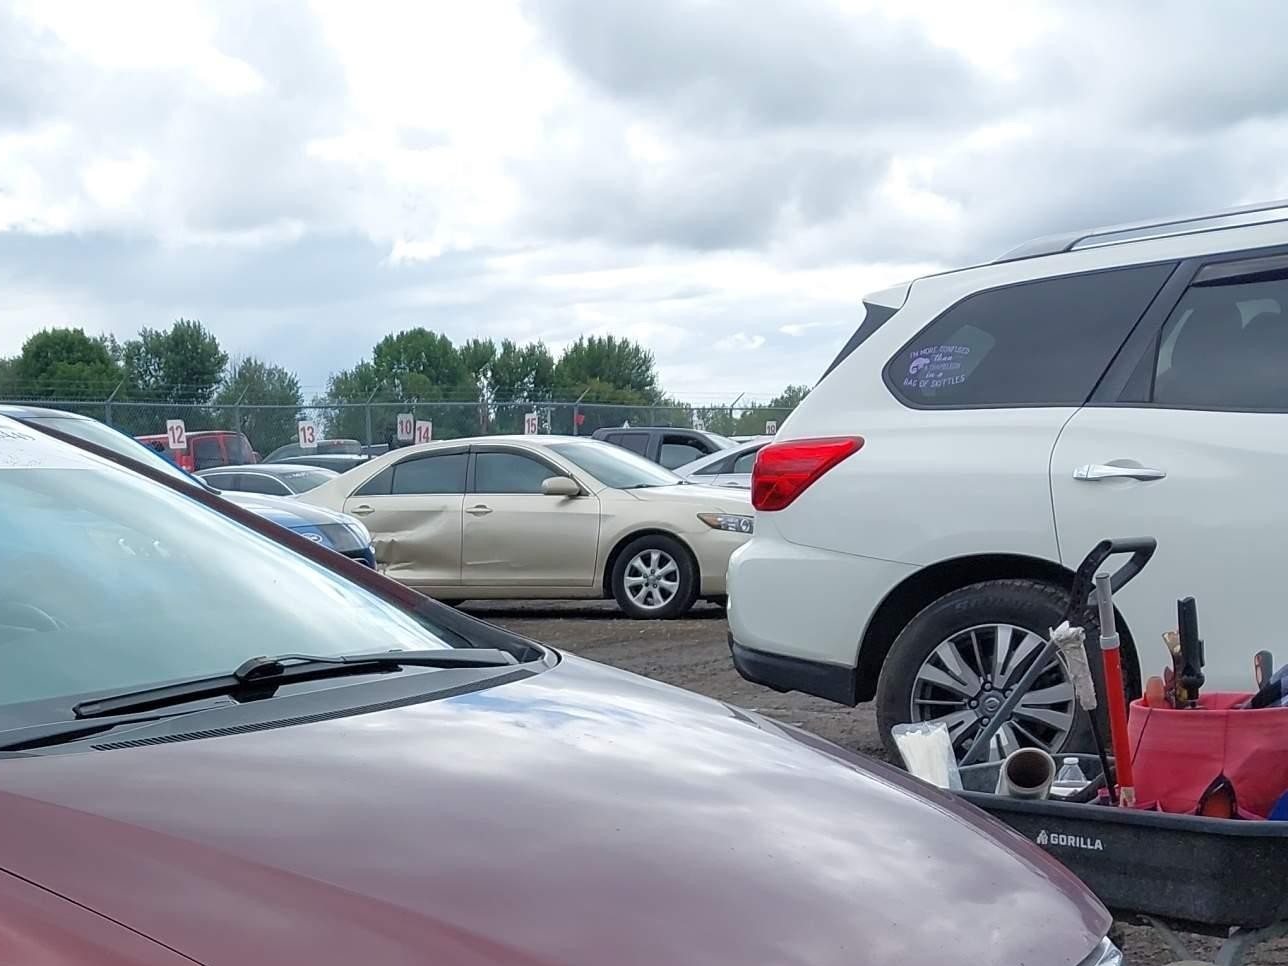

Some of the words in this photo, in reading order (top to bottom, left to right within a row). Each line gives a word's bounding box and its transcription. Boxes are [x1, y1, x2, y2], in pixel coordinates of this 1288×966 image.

[168, 424, 185, 445] 12
[300, 425, 316, 444] 13
[399, 419, 412, 434] 10
[416, 425, 430, 443] 14
[526, 417, 537, 434] 15
[1050, 833, 1103, 851] GORILLA
